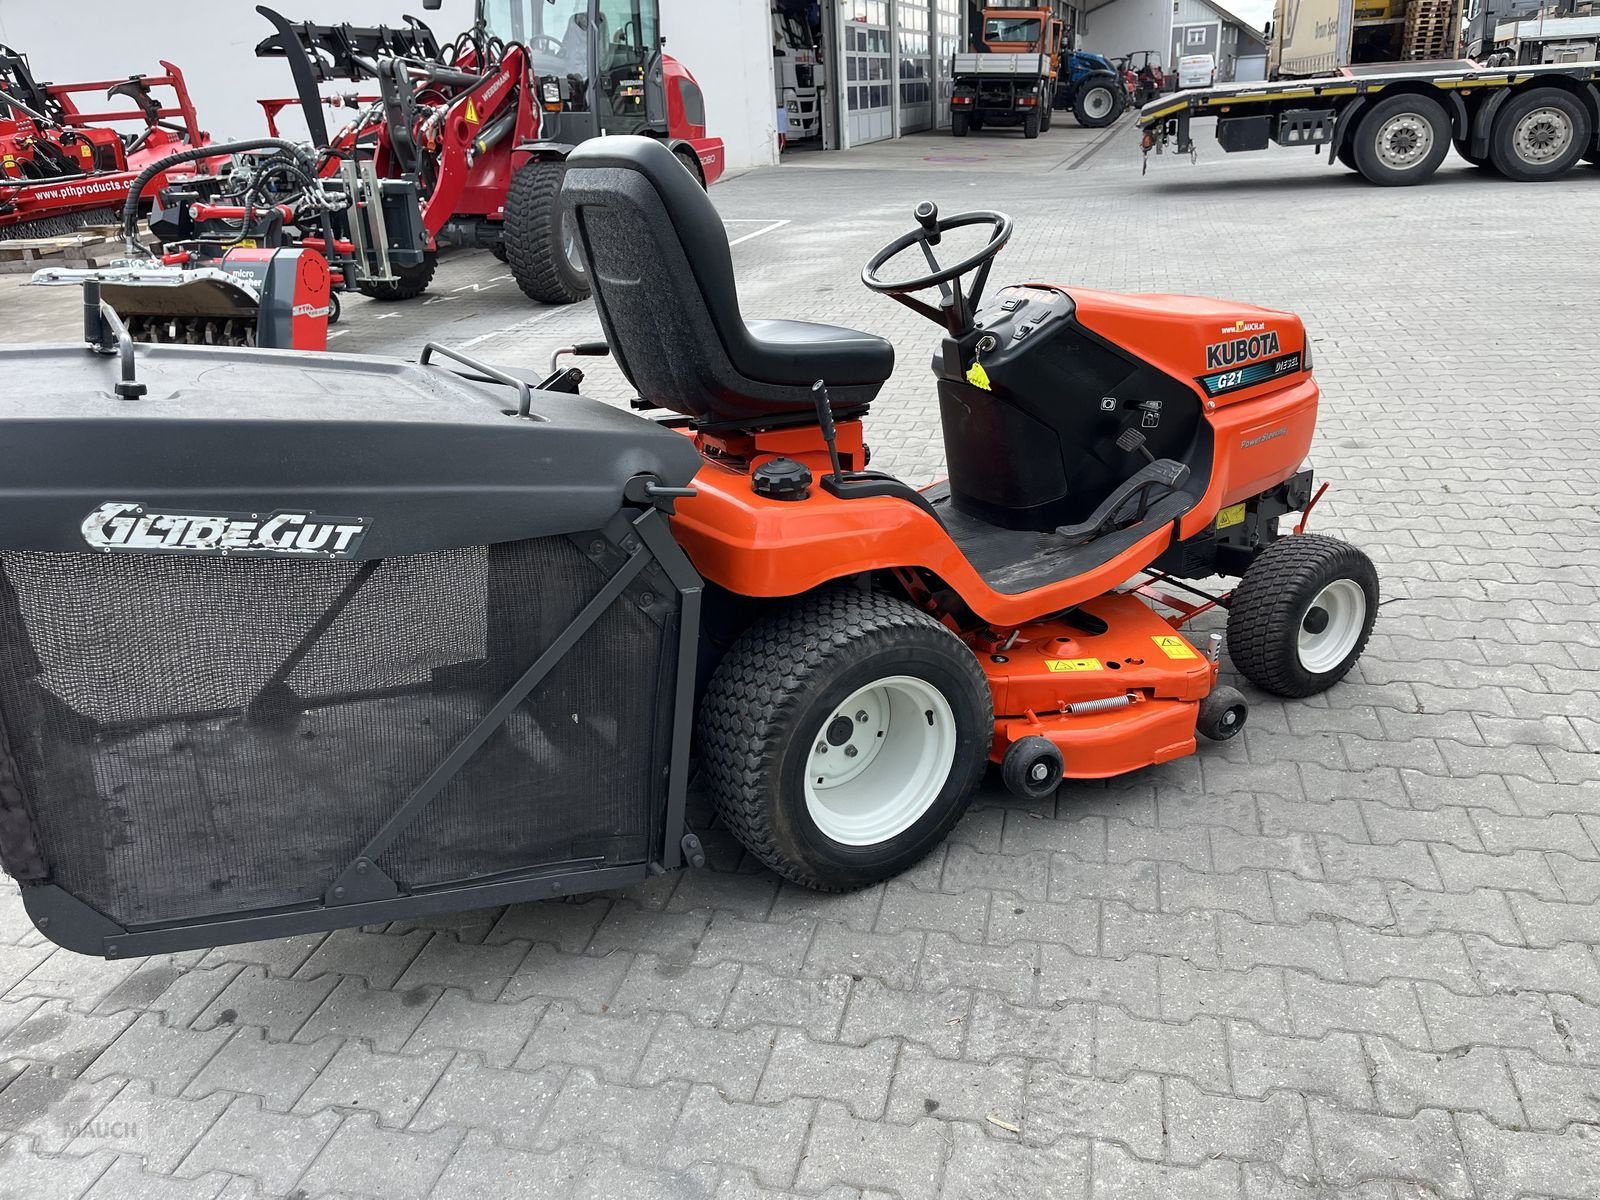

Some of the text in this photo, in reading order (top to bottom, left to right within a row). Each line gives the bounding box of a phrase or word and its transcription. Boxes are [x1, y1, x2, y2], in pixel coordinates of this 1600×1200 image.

[481, 70, 510, 102] WEIDEMANN
[232, 269, 255, 278] micro
[1205, 330, 1281, 371] KUBOTA
[1217, 357, 1299, 389] G21 DIESEL
